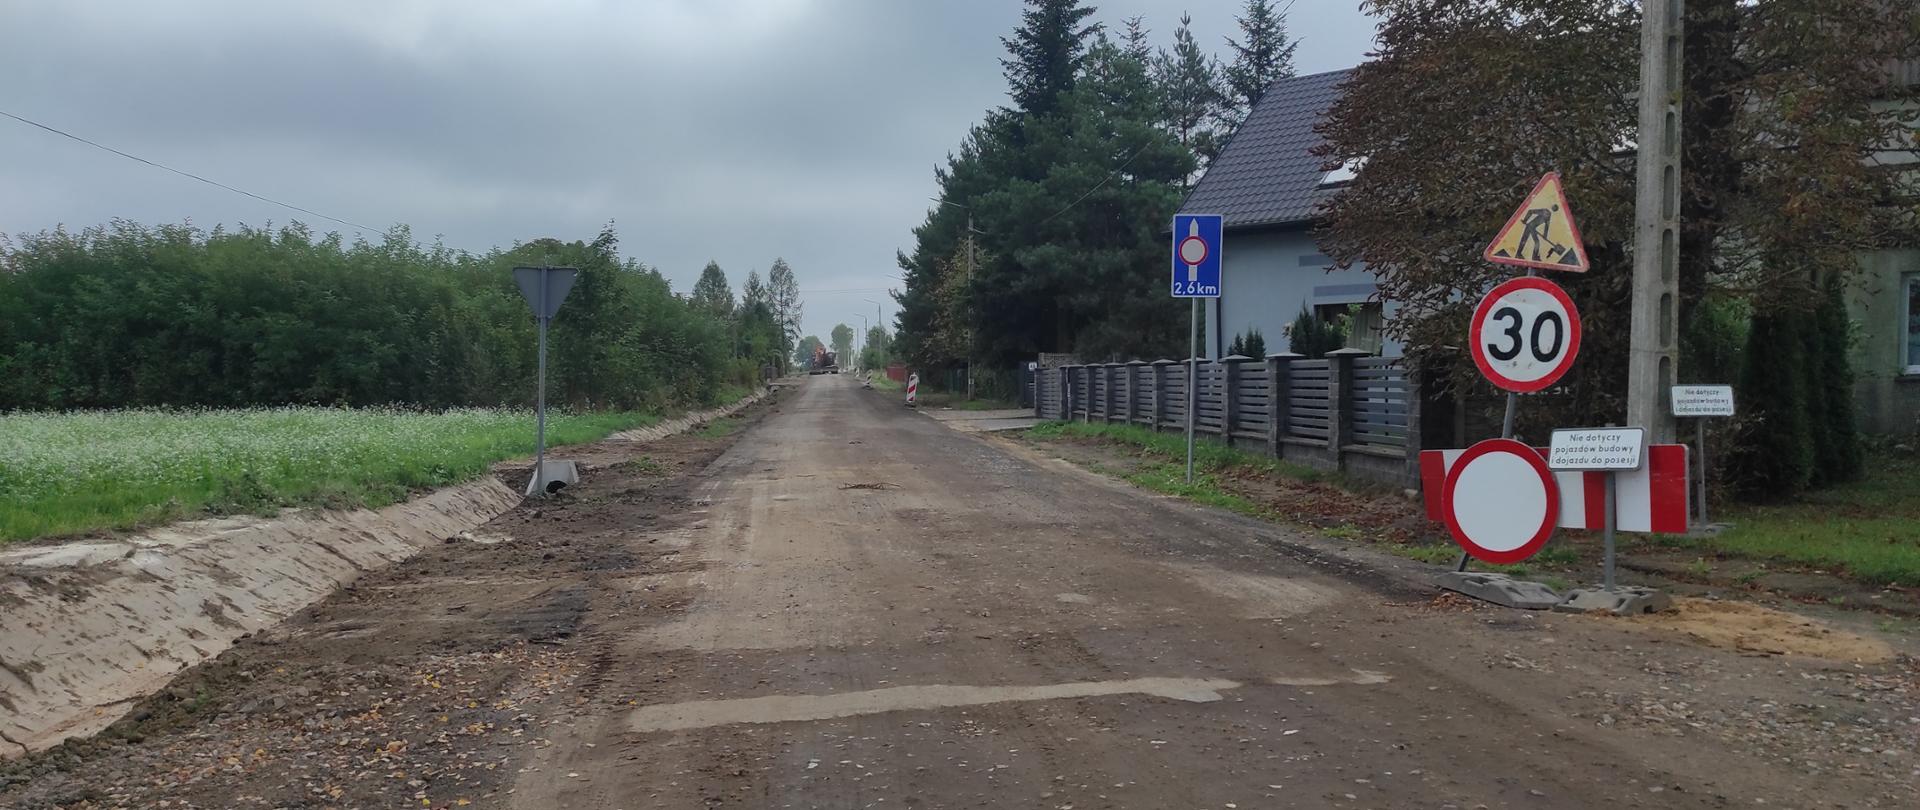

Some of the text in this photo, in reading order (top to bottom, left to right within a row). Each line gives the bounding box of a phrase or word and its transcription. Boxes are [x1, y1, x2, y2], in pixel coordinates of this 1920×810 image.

[1487, 306, 1564, 363] 30
[1569, 433, 1621, 444] Nie dotyczy
[1598, 444, 1634, 455] budowy
[1555, 456, 1589, 466] dojazdu
[1591, 456, 1603, 464] do
[1604, 456, 1636, 466] posesji
